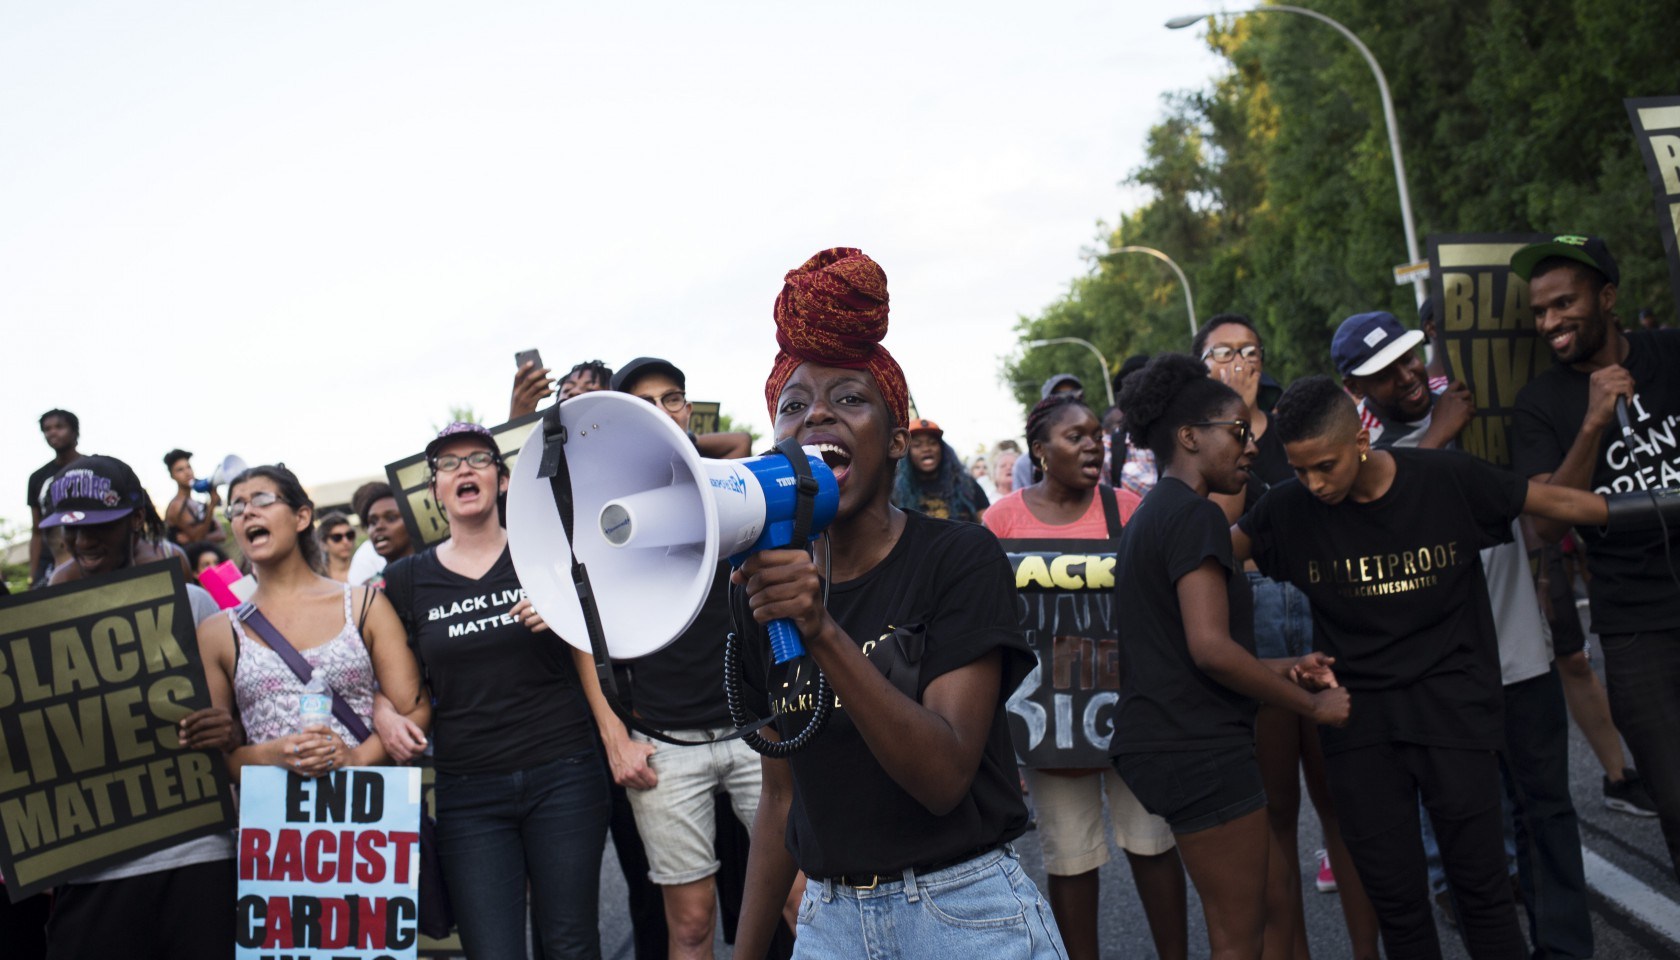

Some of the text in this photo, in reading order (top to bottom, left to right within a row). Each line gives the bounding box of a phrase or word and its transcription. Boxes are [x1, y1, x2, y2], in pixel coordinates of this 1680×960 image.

[1442, 272, 1535, 332] BLA
[1445, 337, 1556, 409] LIV
[1633, 394, 1651, 422] I
[1606, 415, 1680, 470] CAN'
[1014, 554, 1118, 591] ACK
[428, 588, 529, 621] BLACK LIVE
[0, 752, 218, 856] MATTER
[286, 770, 385, 824] END
[240, 828, 419, 884] RACIST
[235, 894, 416, 951] CARDING
